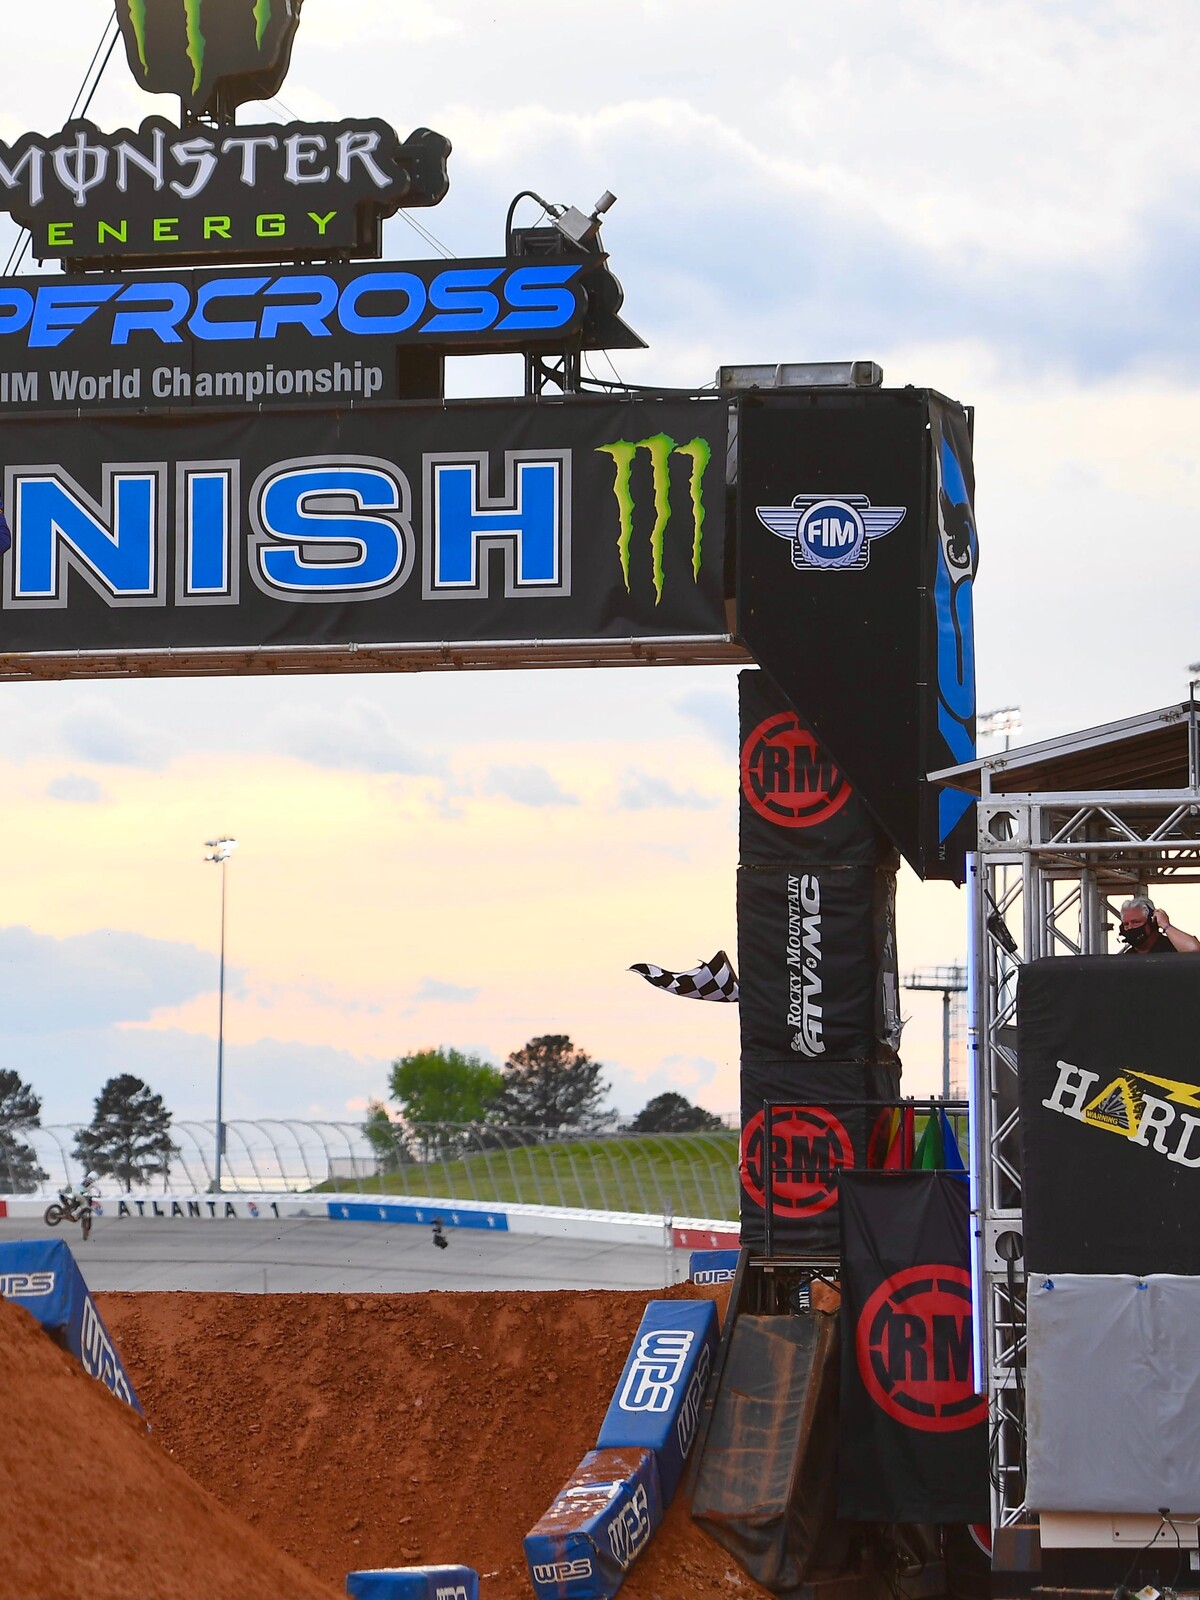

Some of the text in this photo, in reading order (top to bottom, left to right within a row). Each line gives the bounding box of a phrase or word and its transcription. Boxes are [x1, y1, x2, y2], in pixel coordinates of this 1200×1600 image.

[48, 211, 337, 246] ENERGY
[49, 368, 140, 401] World
[152, 360, 383, 402] Championship
[808, 518, 854, 547] FIM
[763, 745, 833, 793] RM
[786, 874, 801, 1029] ROCKY MOUNTAIN
[1087, 1110, 1118, 1124] WARNING
[763, 1135, 830, 1183] RM
[118, 1200, 238, 1218] ATLANTA
[619, 1330, 694, 1413] WPS
[533, 1558, 593, 1584] WPS
